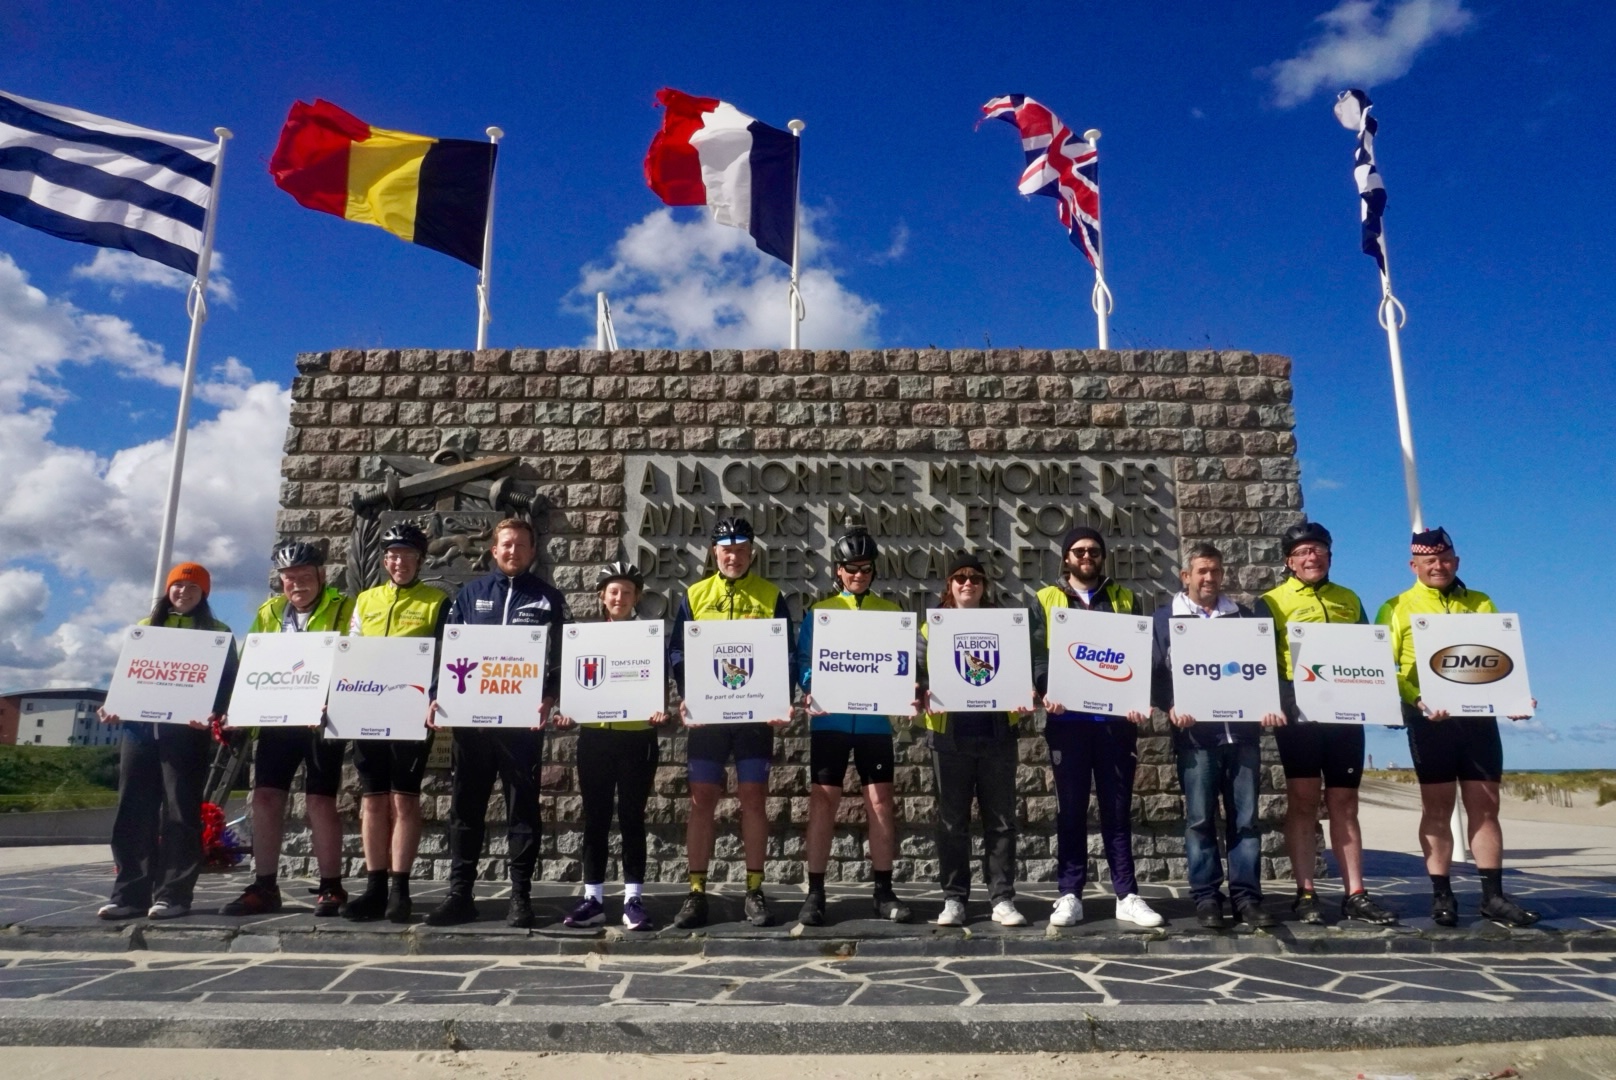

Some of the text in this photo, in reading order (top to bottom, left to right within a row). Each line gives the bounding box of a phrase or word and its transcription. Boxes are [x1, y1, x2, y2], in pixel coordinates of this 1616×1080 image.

[640, 461, 1158, 495] A LA GLORIEUSE MEMOIRE DES
[639, 503, 1161, 537] AVIATEURS MARINS ET SOLDATS
[637, 546, 690, 579] DES
[702, 546, 817, 579] AEES
[1018, 546, 1051, 580] ET
[715, 645, 752, 654] ALBION
[957, 640, 997, 649] ALBION
[819, 648, 893, 664] Pertemps
[1075, 645, 1126, 664] Bache
[1441, 655, 1500, 668] DMG
[131, 659, 209, 671] HOLLYWOOD
[481, 662, 538, 678] SAFARI
[819, 661, 879, 673] Network
[1098, 662, 1119, 671] Group
[1183, 662, 1267, 681] engge
[1332, 665, 1384, 678] Hopton
[127, 667, 207, 683] MONSTER
[336, 680, 388, 696] holiday
[480, 679, 522, 694] PARK
[747, 692, 765, 700] family
